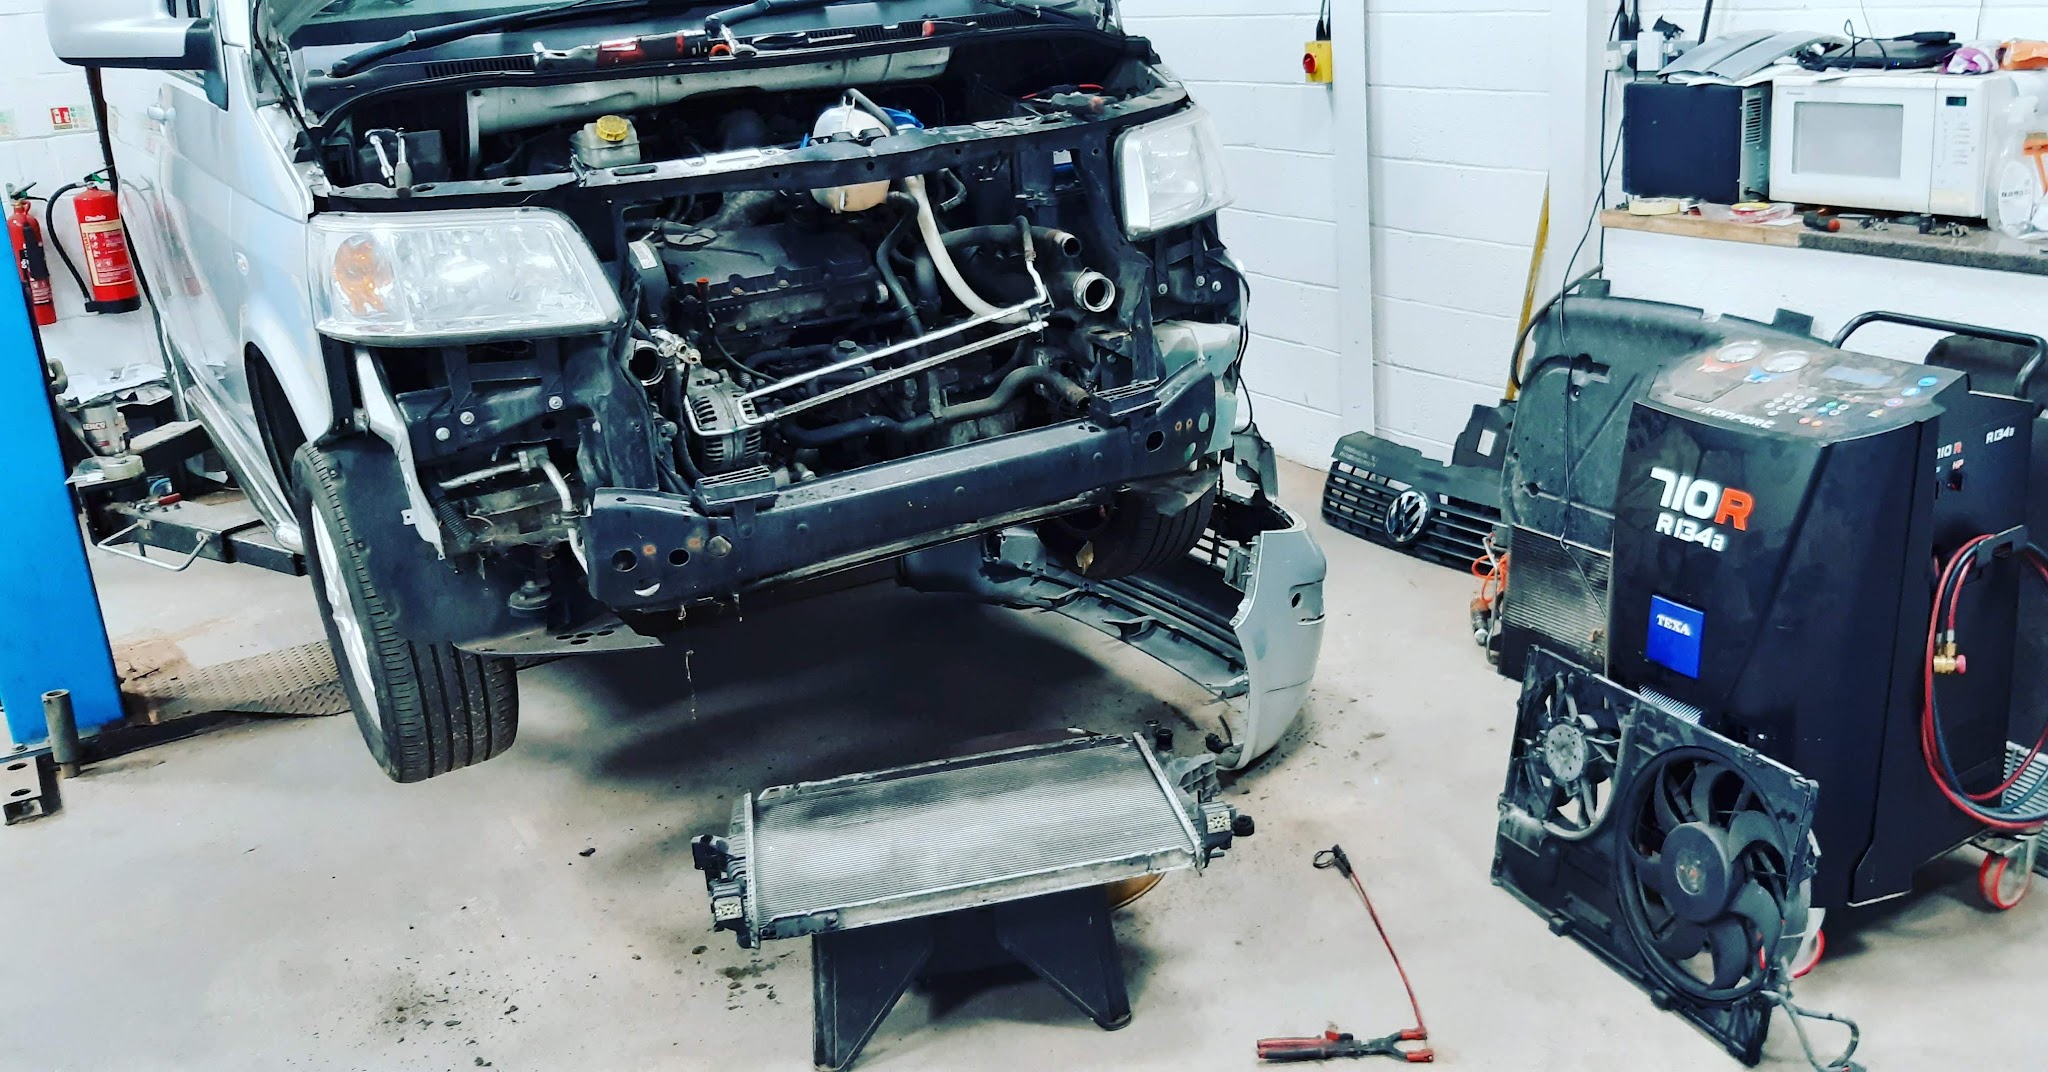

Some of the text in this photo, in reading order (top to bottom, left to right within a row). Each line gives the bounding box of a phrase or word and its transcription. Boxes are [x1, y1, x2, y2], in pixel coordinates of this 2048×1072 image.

[1650, 466, 1754, 531] 710R
[1655, 511, 1727, 552] R134a
[1656, 613, 1691, 637] TEXA
